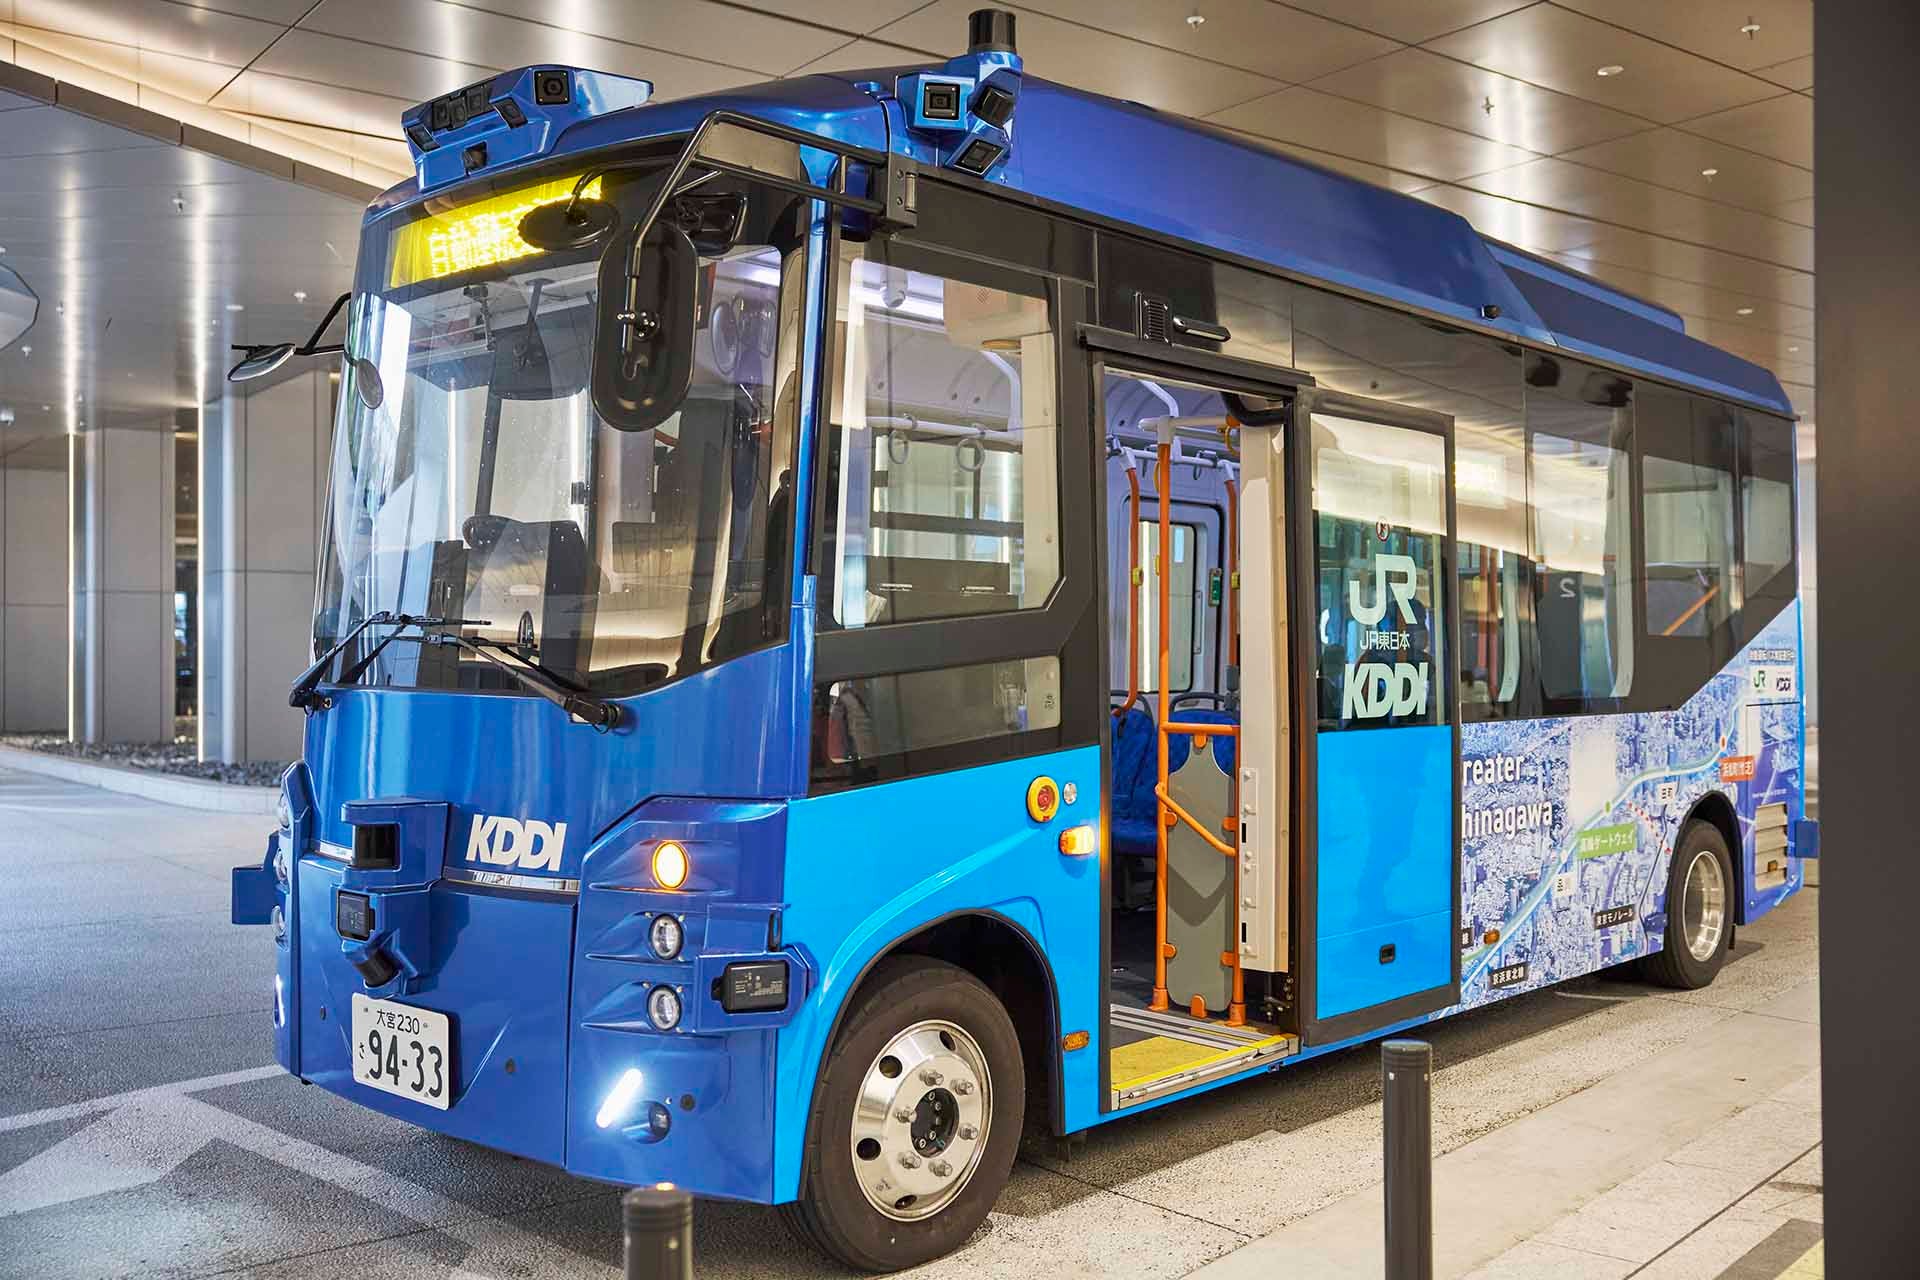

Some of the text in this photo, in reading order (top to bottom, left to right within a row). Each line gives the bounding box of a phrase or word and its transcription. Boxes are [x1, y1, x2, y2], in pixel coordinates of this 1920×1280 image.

[1350, 554, 1417, 625] JR
[1360, 631, 1410, 650] JR東日本
[1342, 663, 1428, 719] KDDI
[1753, 670, 1765, 687] JR
[466, 814, 567, 872] KDDI
[369, 1029, 443, 1098] 94-33
